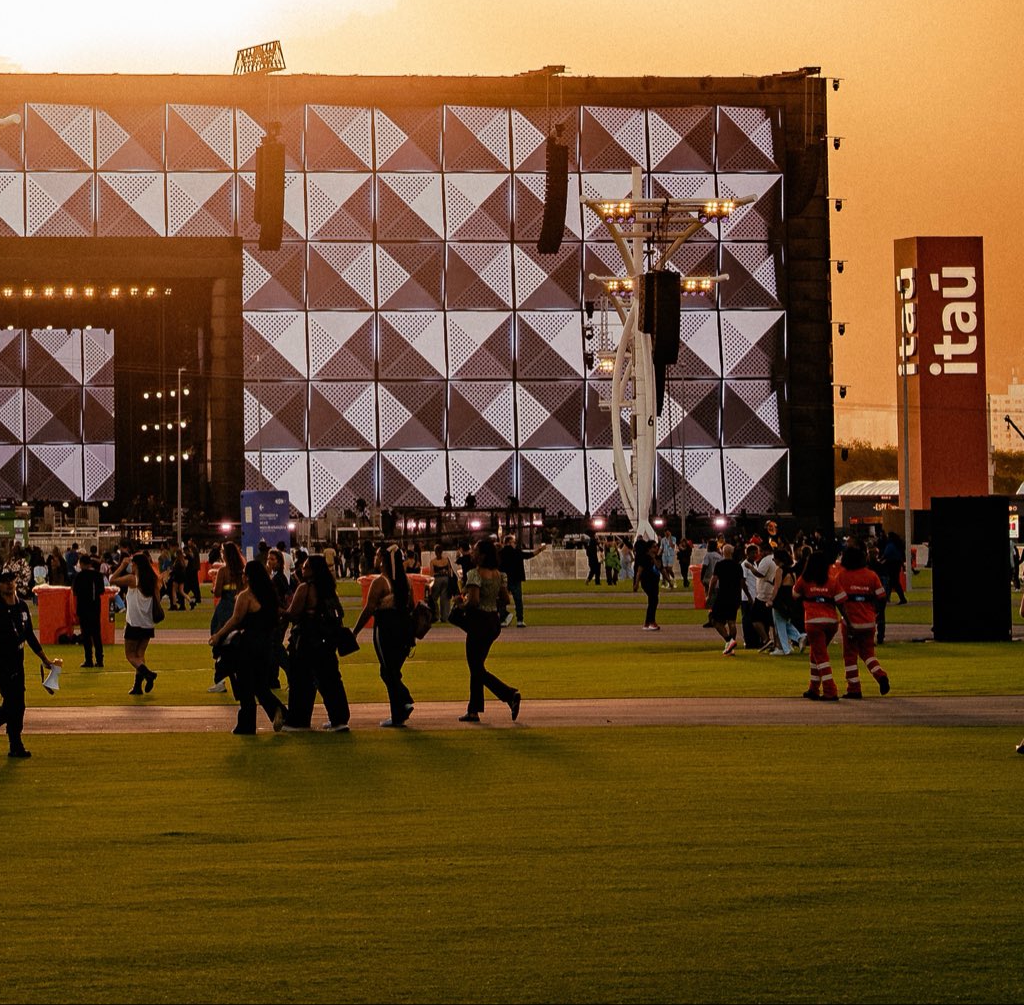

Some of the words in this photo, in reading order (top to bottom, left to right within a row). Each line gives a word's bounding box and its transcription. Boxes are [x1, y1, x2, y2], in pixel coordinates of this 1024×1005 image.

[897, 268, 917, 376] itaú
[929, 267, 977, 376] itaú
[648, 415, 654, 427] 6
